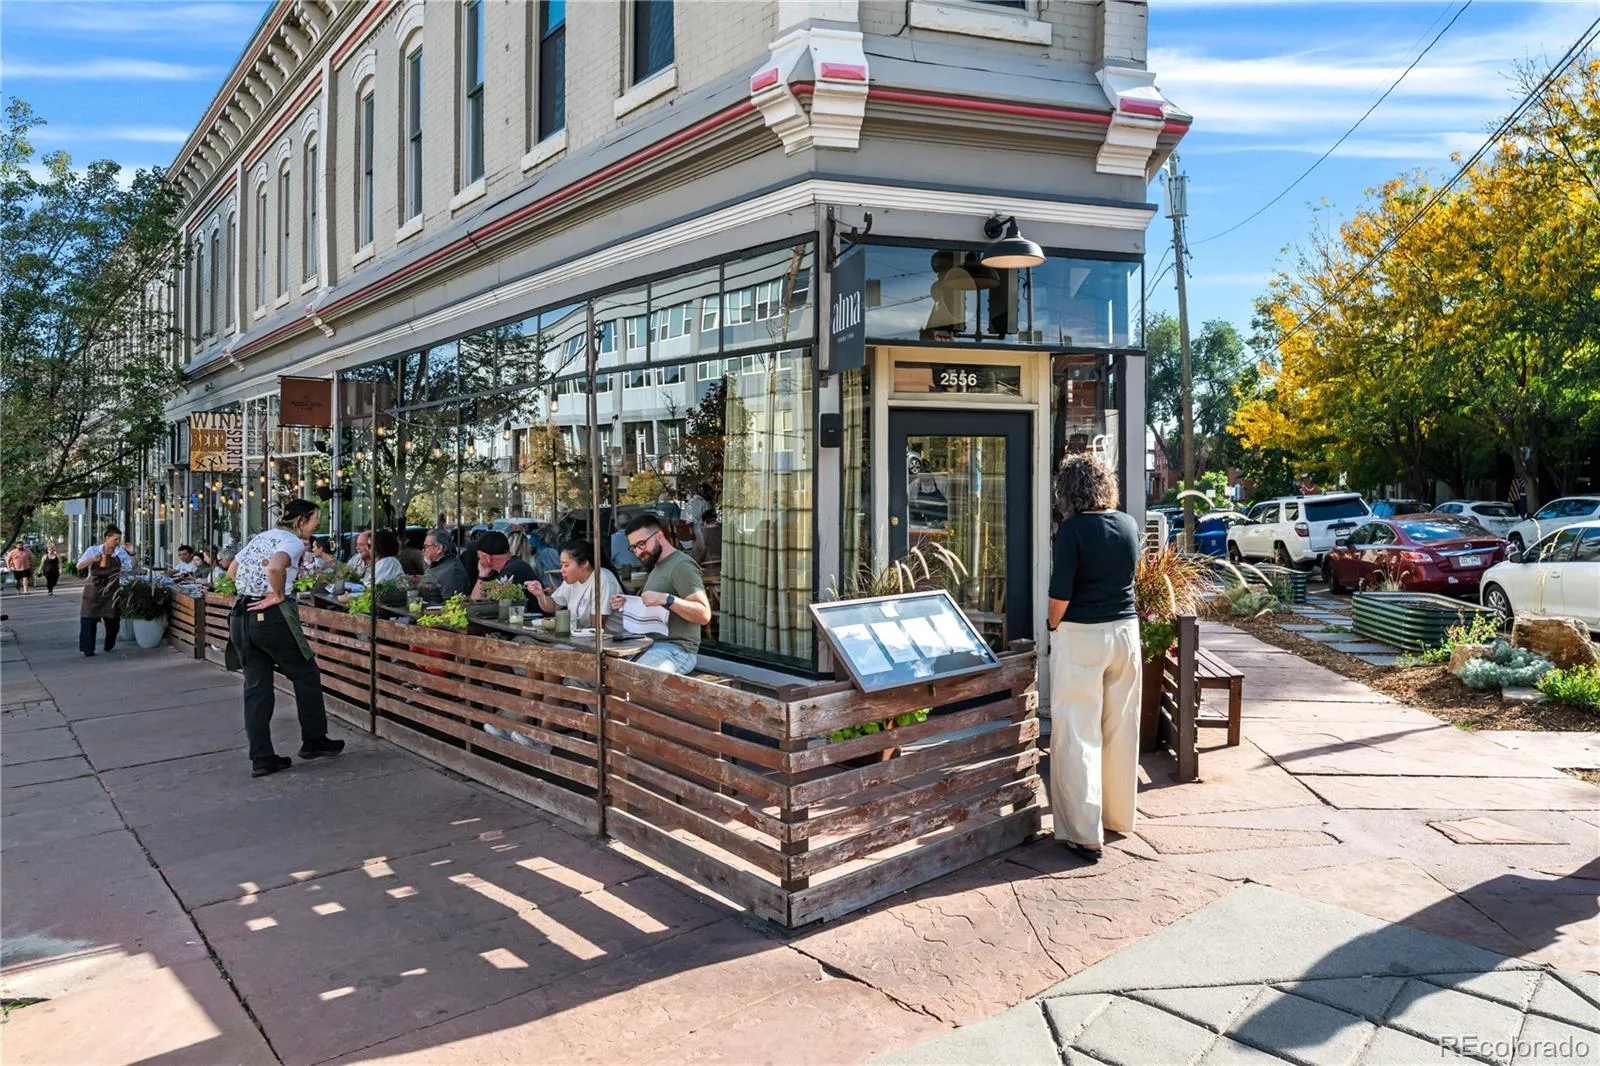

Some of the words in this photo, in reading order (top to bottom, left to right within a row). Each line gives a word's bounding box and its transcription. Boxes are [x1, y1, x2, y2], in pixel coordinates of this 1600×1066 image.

[832, 290, 861, 335] alma
[940, 372, 978, 386] 2556
[192, 411, 243, 430] WINE
[191, 429, 227, 453] BEER
[226, 429, 243, 473] SPIRITS
